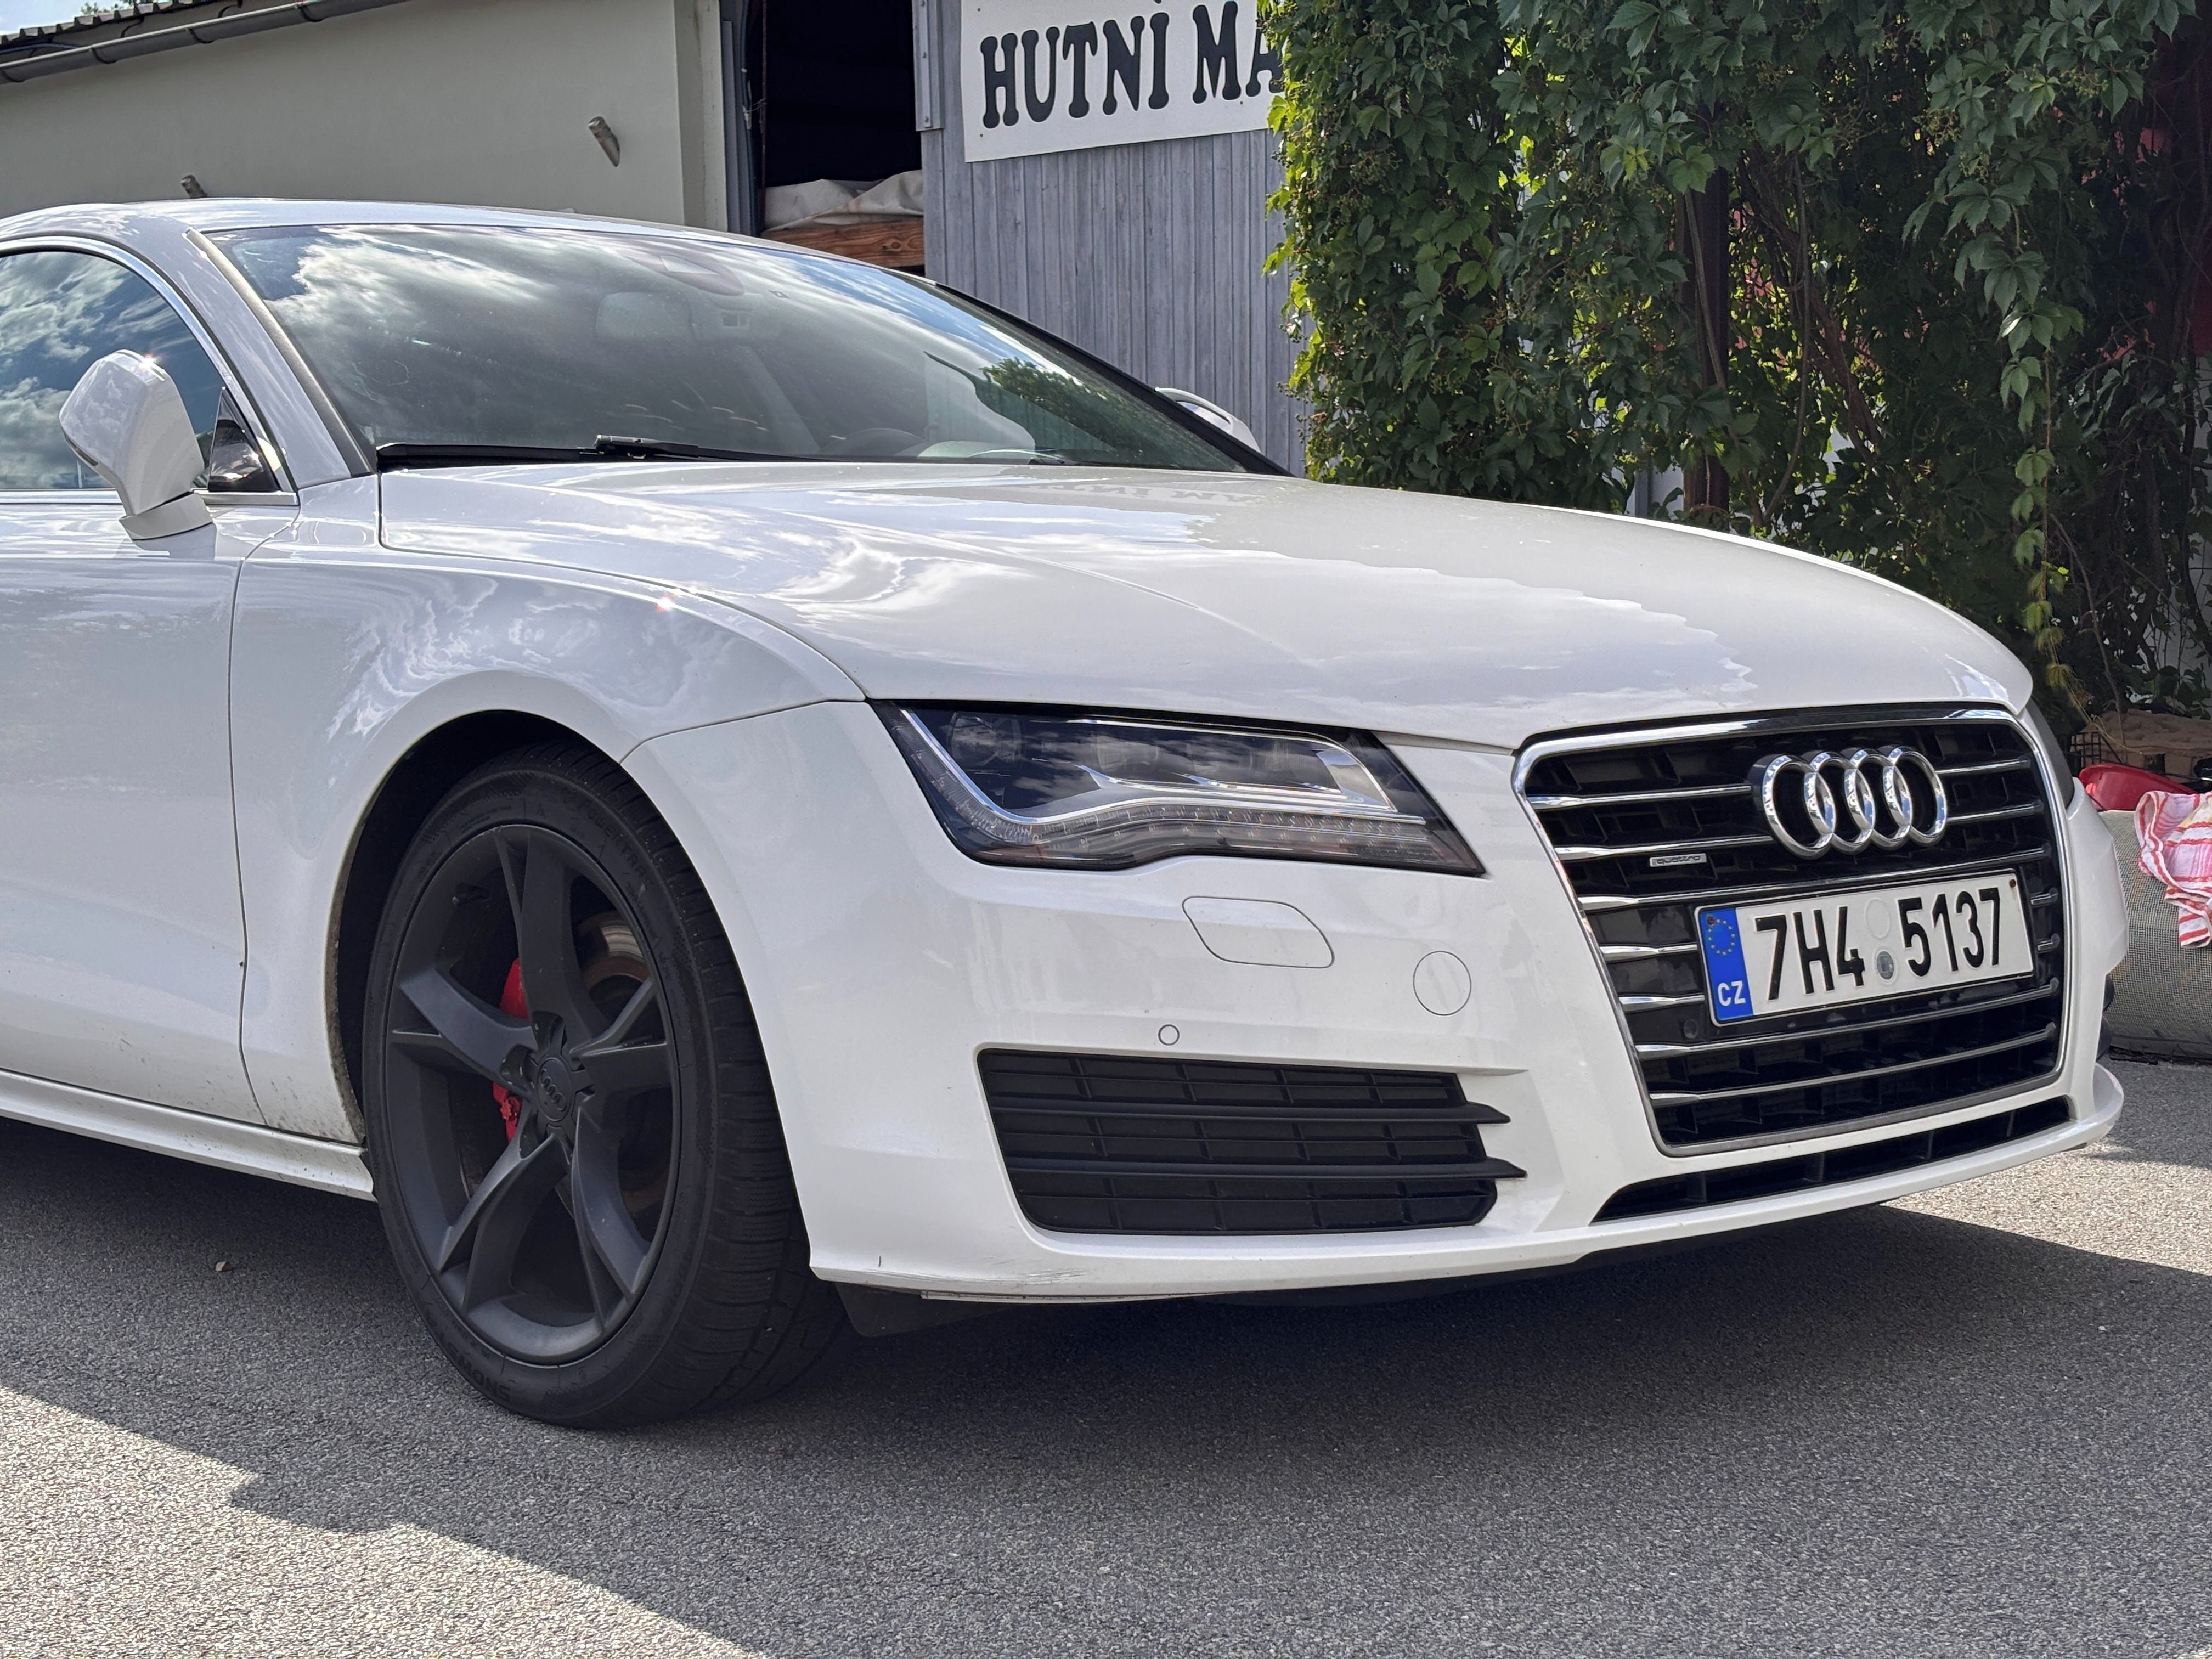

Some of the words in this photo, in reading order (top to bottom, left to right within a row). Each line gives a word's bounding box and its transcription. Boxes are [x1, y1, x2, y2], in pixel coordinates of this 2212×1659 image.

[1755, 906, 1865, 1001] 7H4
[1898, 887, 2000, 978] 5137
[1718, 981, 1747, 1007] CZ
